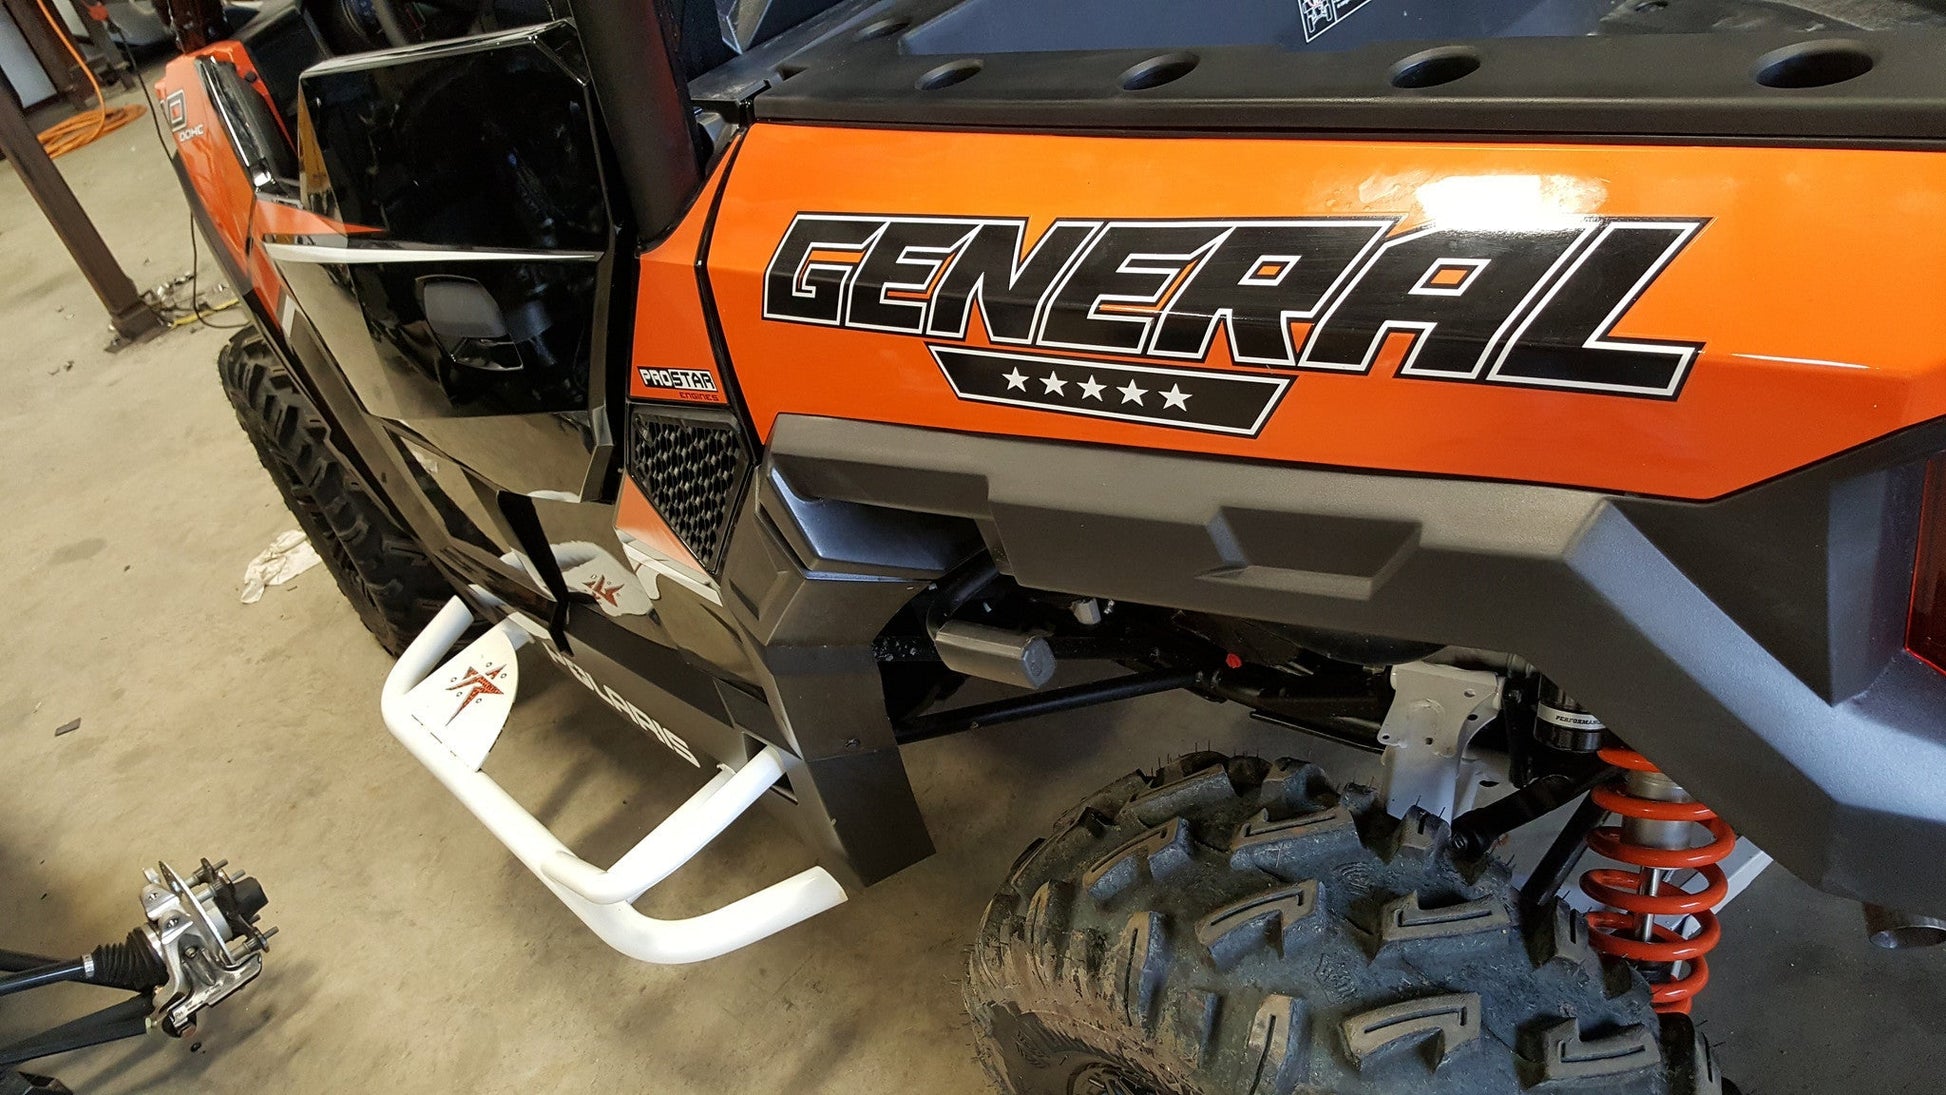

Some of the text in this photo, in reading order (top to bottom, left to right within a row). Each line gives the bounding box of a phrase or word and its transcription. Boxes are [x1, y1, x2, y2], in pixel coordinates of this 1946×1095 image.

[180, 124, 204, 142] DOHC
[762, 212, 1714, 400] GENERAL
[638, 367, 717, 391] PROSTAR
[679, 391, 719, 401] ENGINES
